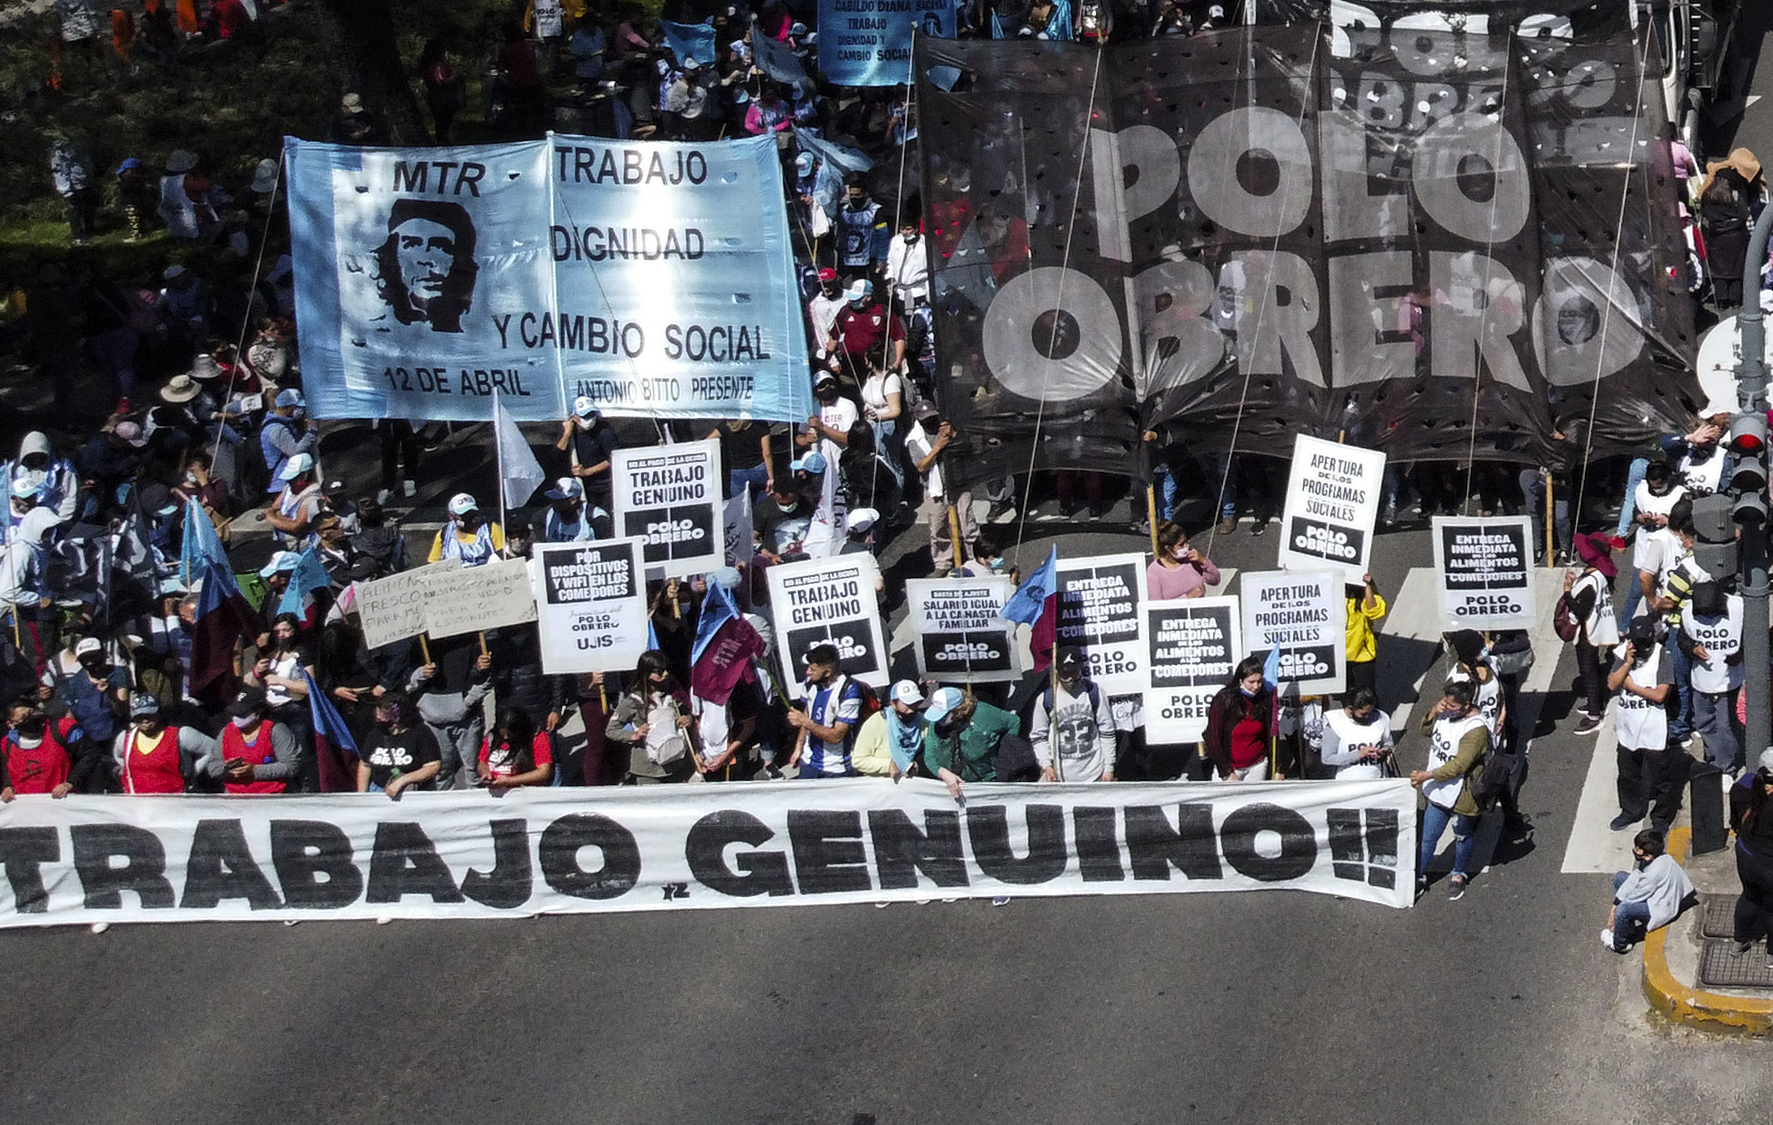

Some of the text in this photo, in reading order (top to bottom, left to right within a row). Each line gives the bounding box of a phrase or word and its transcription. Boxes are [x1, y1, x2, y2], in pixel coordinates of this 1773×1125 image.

[835, 0, 875, 12] CABILDO
[878, 0, 911, 12] DIANA
[847, 18, 887, 29] TRABAJO
[838, 35, 885, 46] DIGNIDAD Y
[837, 50, 872, 61] CAMBIO
[554, 146, 708, 185] TRABAJO
[394, 160, 487, 197] MTR
[1092, 105, 1532, 263] POLO
[549, 225, 705, 261] DIGNIDAD
[981, 251, 1645, 404] OBRERO
[492, 311, 771, 361] Y CAMBIO SOCIAL
[384, 367, 531, 396] 12 DE ABRIL
[576, 375, 754, 403] ANTONIO BITTO PRESENTE
[1310, 453, 1363, 477] APERTURA
[630, 464, 705, 488] TRABAJO
[632, 482, 705, 506] GENUINO
[1302, 478, 1366, 505] PROGRAMAS
[1305, 500, 1355, 522] SOCIALES
[647, 519, 693, 535] POLO
[1306, 525, 1348, 544] POLO
[643, 527, 705, 545] OBRERO
[1455, 534, 1511, 544] ENTREGA
[1295, 536, 1357, 559] OBRERO
[1451, 543, 1517, 554] INMEDIATA
[576, 551, 600, 564] POR
[1450, 557, 1519, 568] ALIMENTOS
[550, 560, 628, 578] DISPOSITIVOS
[1450, 571, 1523, 582] COMEDORES
[552, 572, 629, 589] Y WIFI EN LOS
[1067, 575, 1125, 591] ENTREGA
[558, 583, 629, 601] COMEDORES
[788, 580, 858, 605] TRABAJO
[1063, 586, 1130, 602] INMEDIATA
[1260, 584, 1321, 602] APERTURA
[1465, 595, 1510, 605] POLO
[792, 599, 861, 624] GENUINO
[923, 599, 1000, 611] SALARIO IGUAL
[1062, 603, 1132, 619] ALIMENTOS
[1455, 604, 1522, 615] OBRERO
[579, 614, 610, 623] POLO
[926, 609, 998, 620] A LA CANASTA
[1255, 608, 1328, 627] PROGRAMAS
[571, 621, 619, 632] OBRERO
[939, 618, 989, 630] FAMILIAR
[1062, 622, 1137, 637] COMEDORES
[1162, 617, 1217, 630] ENTREGA
[1157, 628, 1223, 642] INMEDIATA
[1264, 628, 1319, 645] SOCIALES
[1696, 628, 1728, 639] POLO
[935, 650, 1000, 661] OBRERO
[945, 643, 989, 653] POLO
[1156, 646, 1225, 658] ALIMENTOS
[1155, 664, 1229, 678] COMEDORES
[1171, 694, 1214, 706] POLO
[0, 812, 642, 914] TRABAJO
